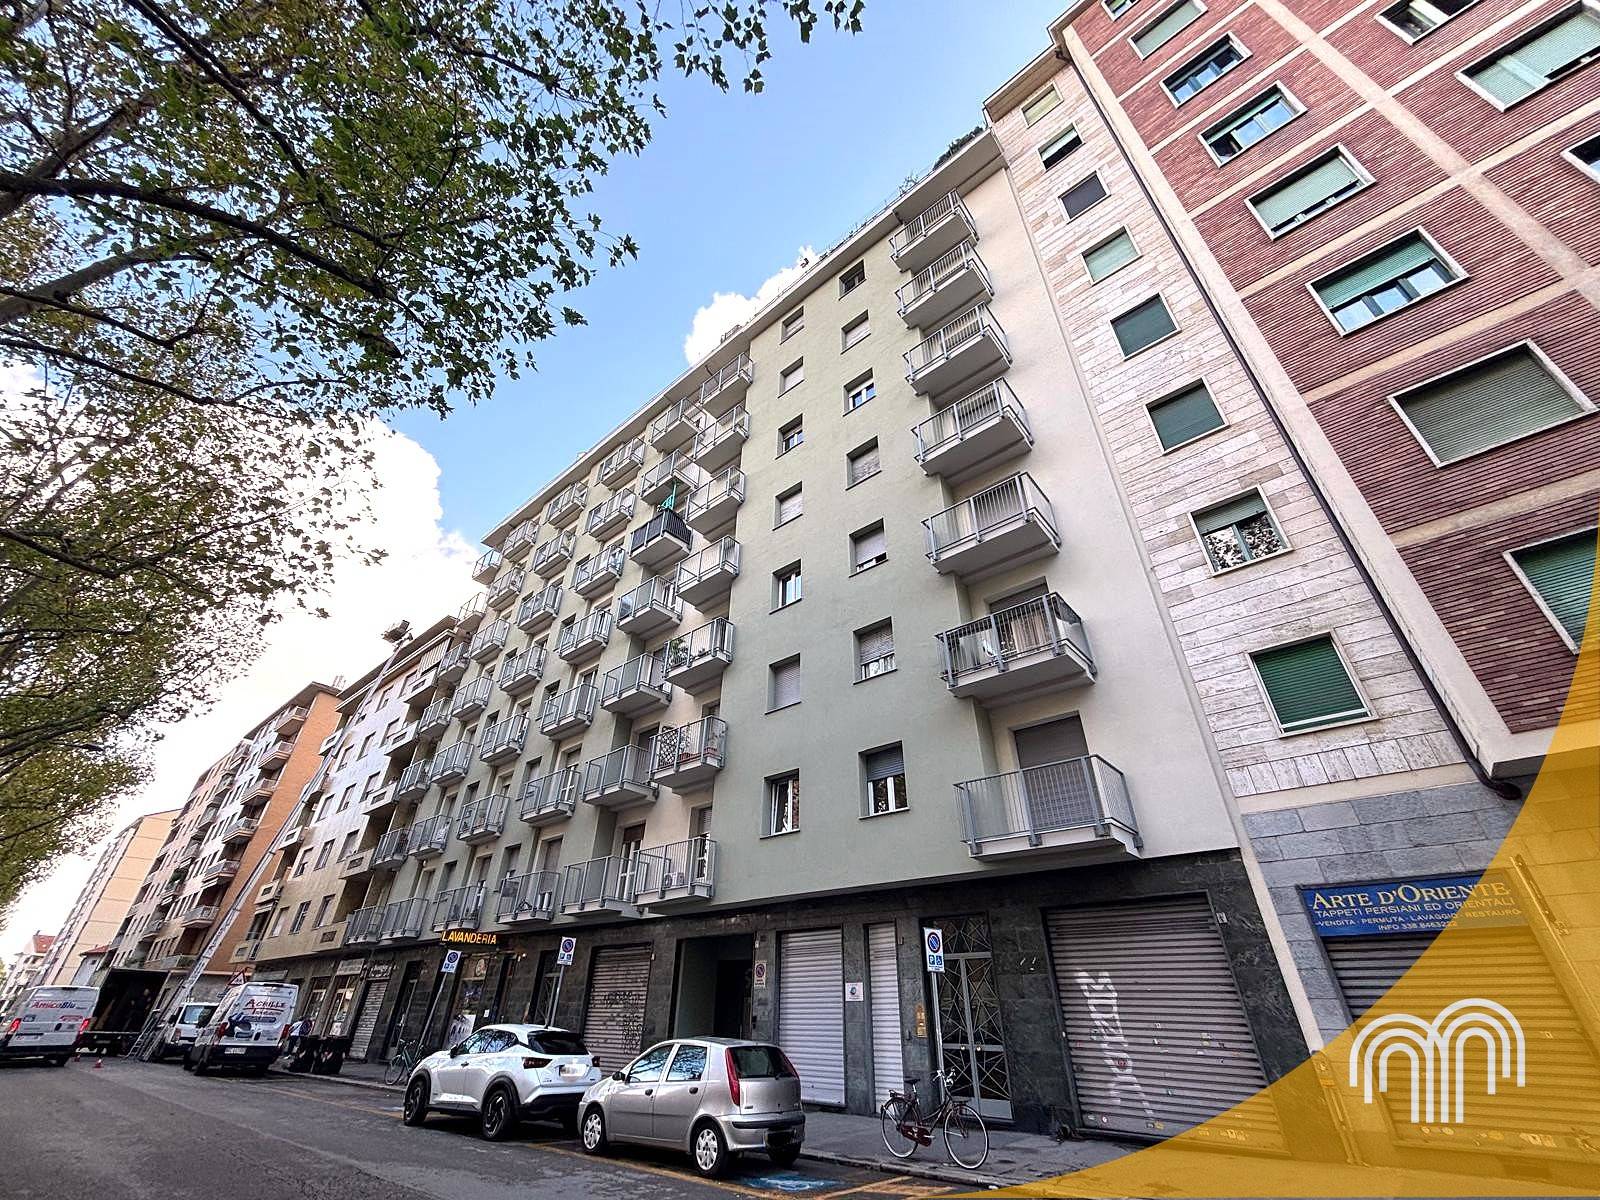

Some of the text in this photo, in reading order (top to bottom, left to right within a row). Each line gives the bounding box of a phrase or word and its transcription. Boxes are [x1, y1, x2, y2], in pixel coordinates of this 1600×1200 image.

[1312, 881, 1511, 910] ARTE D'ORIENTE
[1315, 897, 1516, 918] TAPPETI PERSIANI ED ORIENTALI
[441, 930, 498, 945] LAVANDERIA
